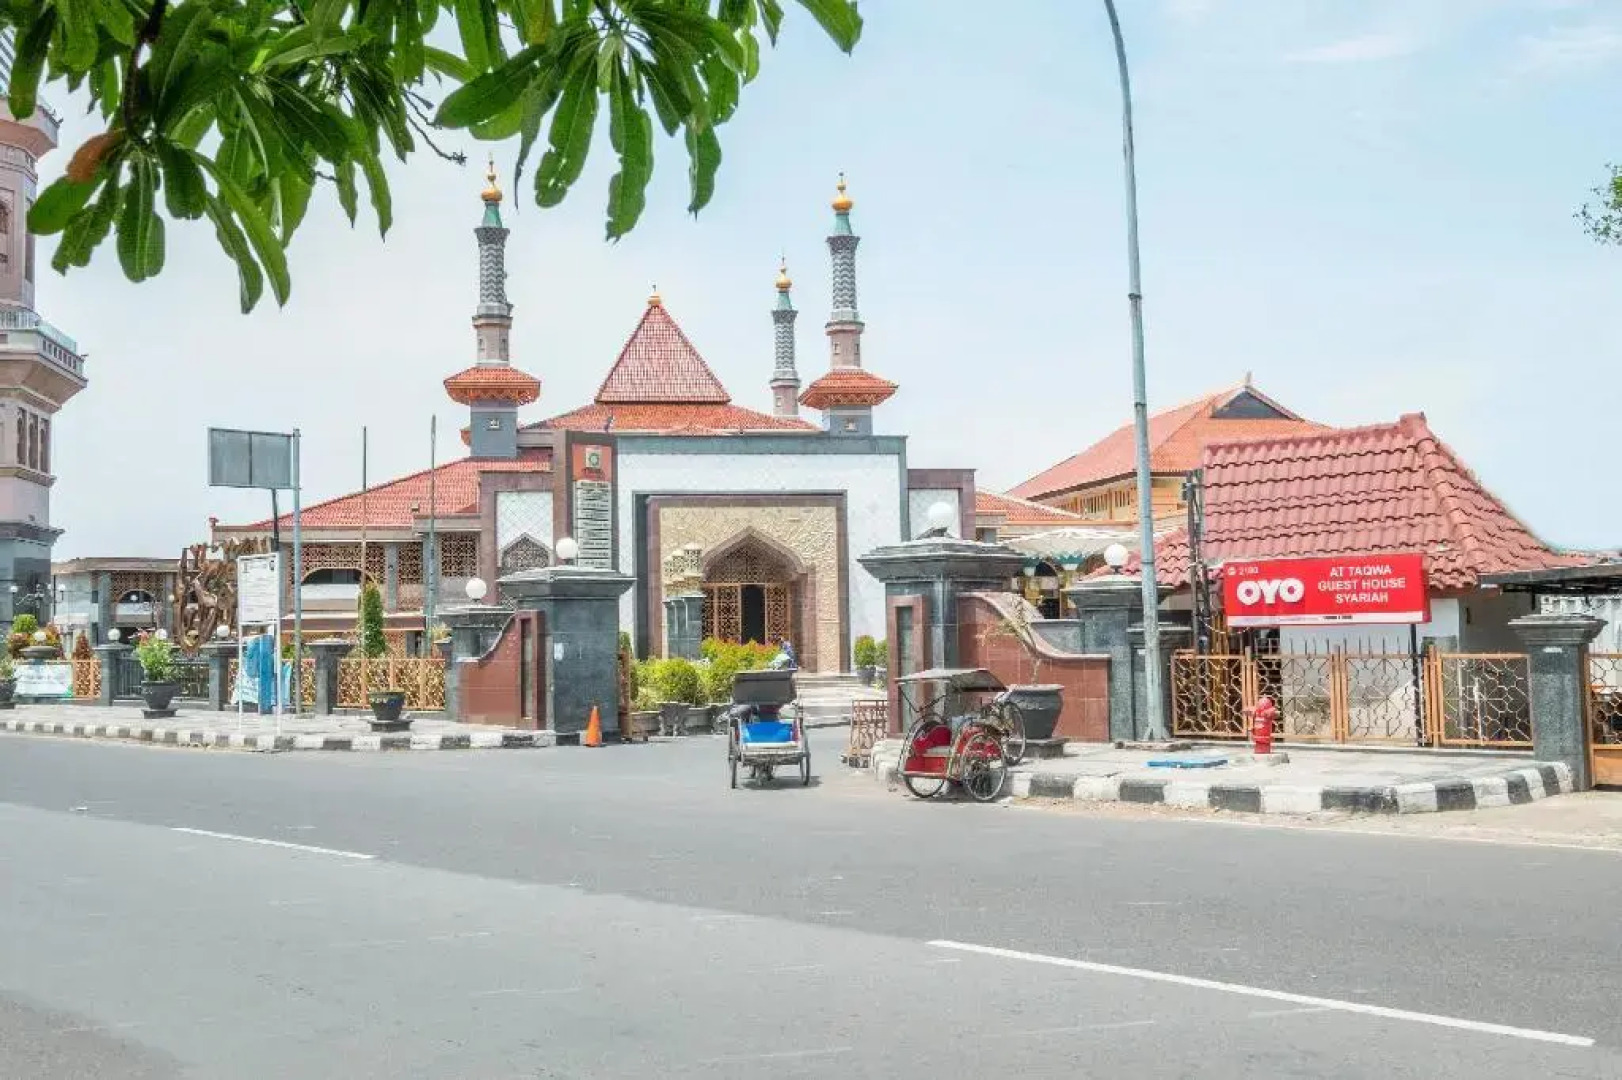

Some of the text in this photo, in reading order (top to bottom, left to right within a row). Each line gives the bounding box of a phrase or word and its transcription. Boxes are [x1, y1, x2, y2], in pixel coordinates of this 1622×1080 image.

[1330, 565, 1392, 577] AT TAQWA
[1236, 578, 1304, 605] OYO
[1317, 577, 1406, 592] GUEST HOUSE
[1335, 591, 1389, 604] SYARIAH
